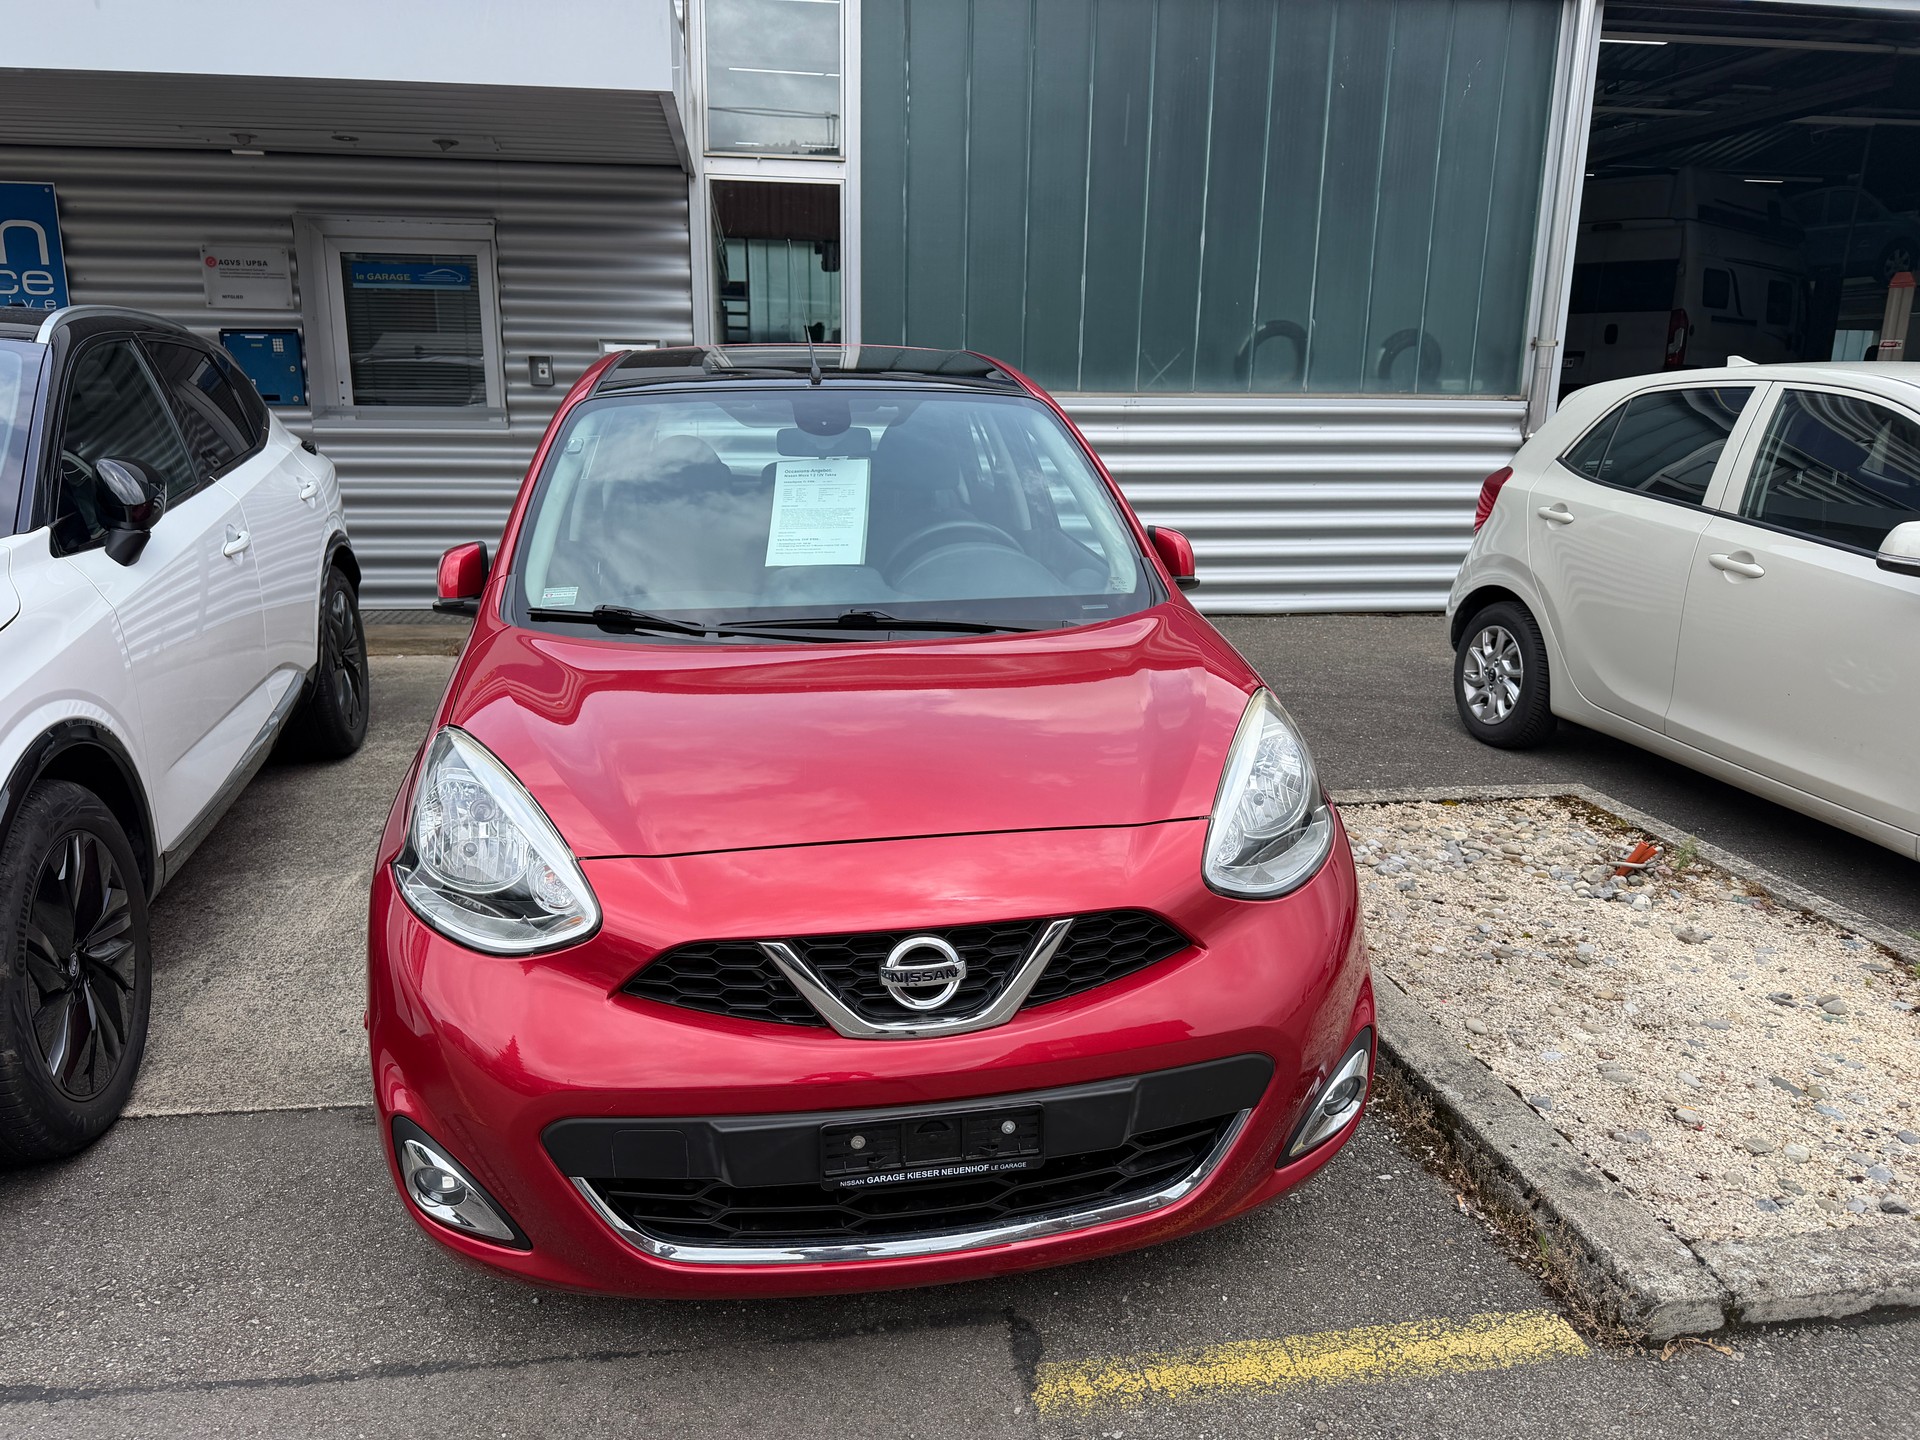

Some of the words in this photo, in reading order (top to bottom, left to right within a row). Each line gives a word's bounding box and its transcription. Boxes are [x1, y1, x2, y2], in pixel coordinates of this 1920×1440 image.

[246, 259, 268, 267] UPSA
[355, 272, 365, 280] le
[366, 272, 411, 281] GARAGE
[890, 967, 957, 983] NISSAN
[839, 1179, 865, 1188] NISSAN
[866, 1172, 906, 1184] GARAGE
[906, 1168, 940, 1180] KIESER
[941, 1164, 990, 1176] NEUENHOF
[1000, 1161, 1027, 1170] GARAGE
